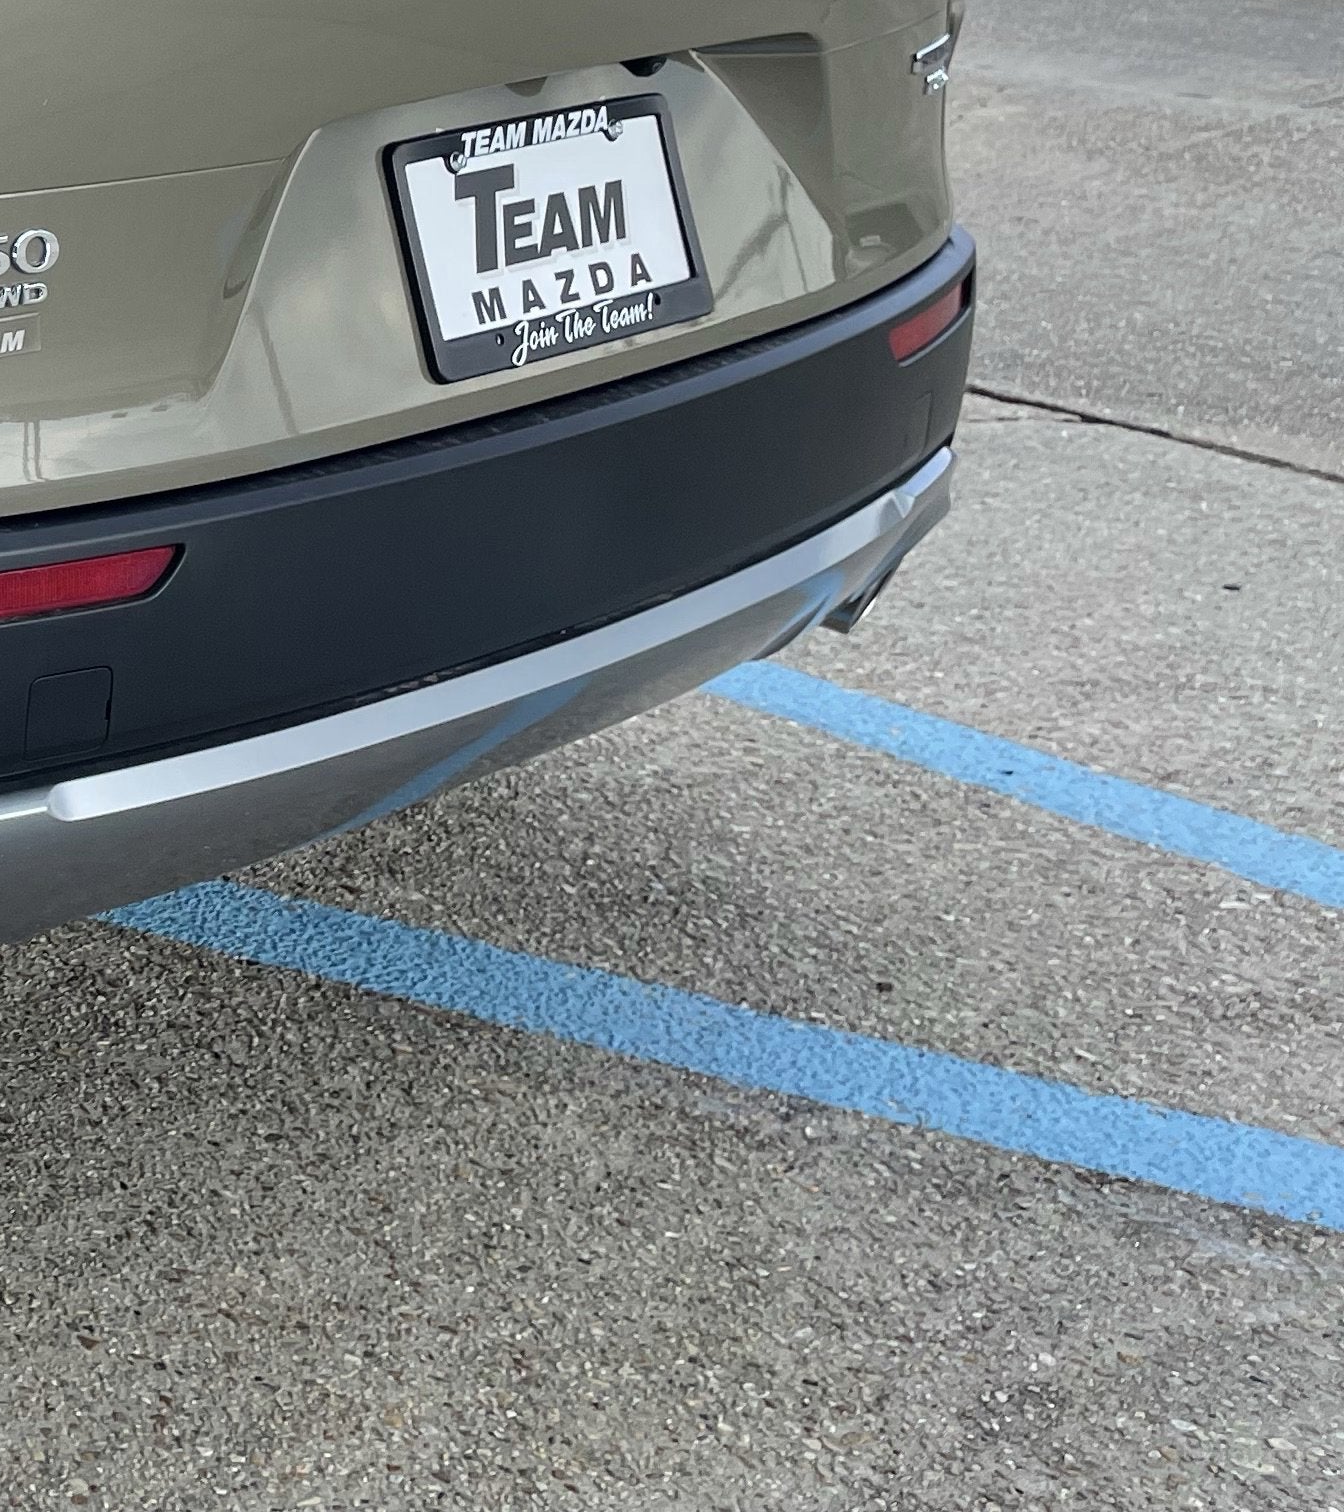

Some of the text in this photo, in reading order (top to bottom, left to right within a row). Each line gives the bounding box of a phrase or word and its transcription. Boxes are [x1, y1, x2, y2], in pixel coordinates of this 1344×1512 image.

[461, 105, 610, 157] TEAM MAZDA
[454, 163, 627, 274] TEAM
[471, 253, 653, 325] MAZDA
[512, 292, 655, 366] Join The Team!
